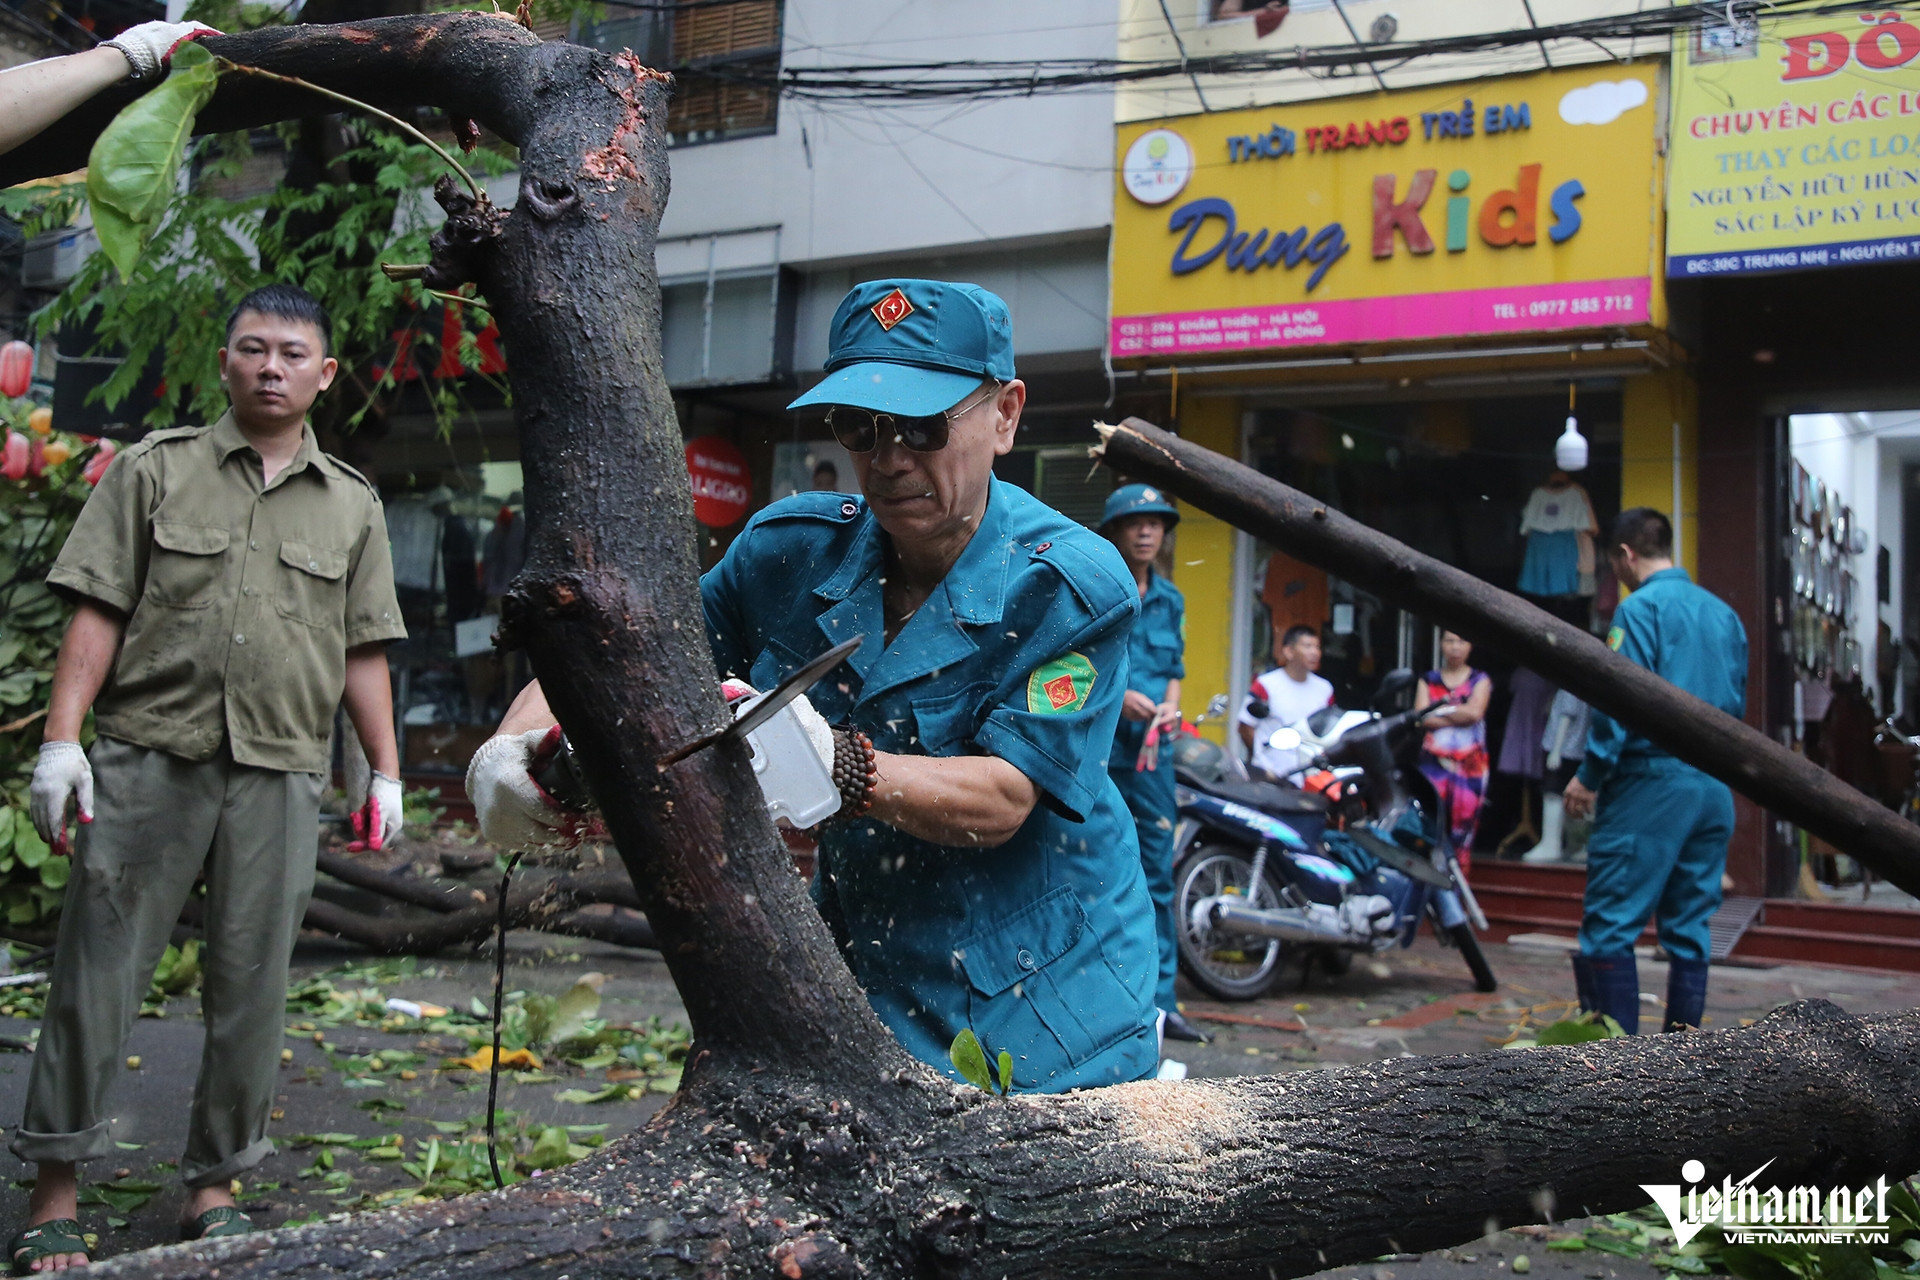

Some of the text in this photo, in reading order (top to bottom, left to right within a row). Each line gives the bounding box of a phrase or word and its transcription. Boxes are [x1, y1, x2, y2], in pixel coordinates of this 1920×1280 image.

[1226, 98, 1532, 163] THỜI TRANG TRẺ EM
[1690, 101, 1817, 138] CHUYÊN
[1827, 90, 1889, 122] CÁC
[1715, 147, 1791, 174] THAY
[1801, 136, 1861, 166] CÁC
[1689, 175, 1794, 207] NGUYỄN
[1168, 163, 1586, 293] Dung Kids
[1773, 205, 1823, 233] LẬP
[1270, 310, 1290, 325] HÀ
[1529, 299, 1567, 317] 0977
[1603, 294, 1634, 312] 712
